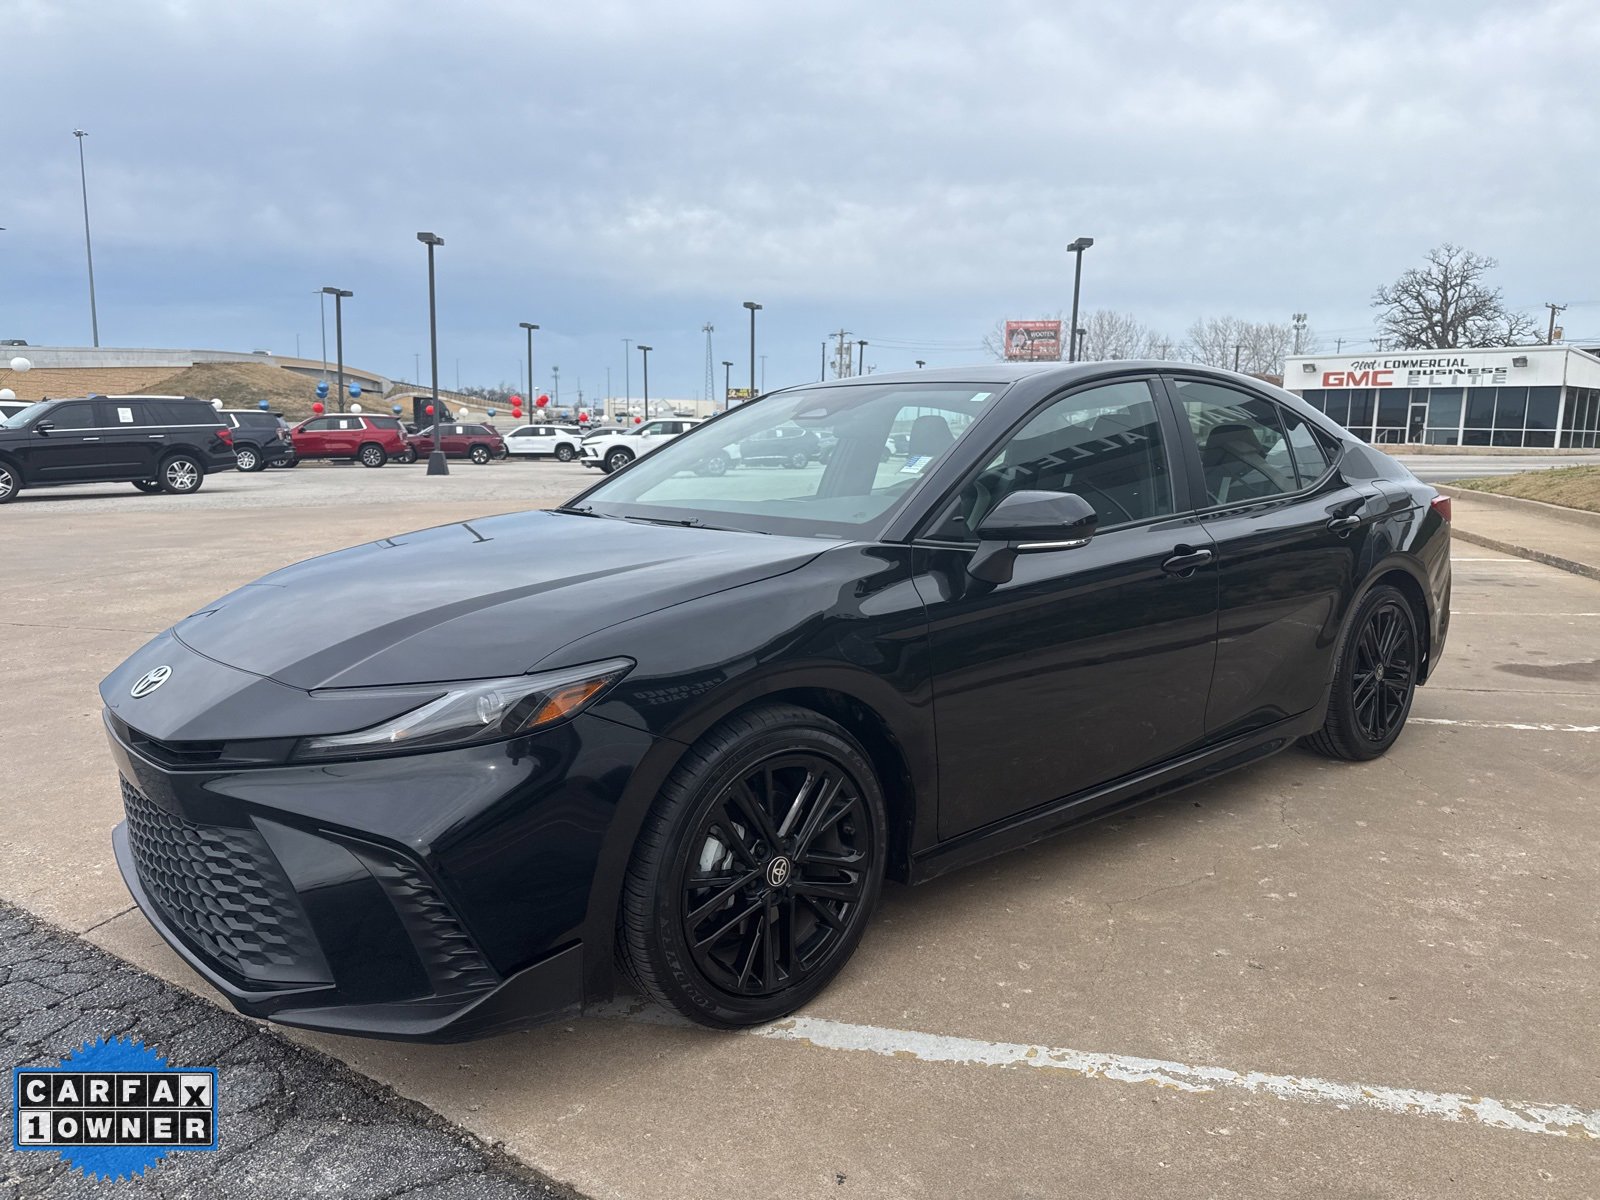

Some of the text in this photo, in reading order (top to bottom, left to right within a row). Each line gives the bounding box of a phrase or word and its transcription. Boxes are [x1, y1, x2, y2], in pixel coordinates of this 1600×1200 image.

[1351, 359, 1377, 371] Fleet
[1383, 358, 1469, 369] COMMERCIAL
[1408, 366, 1508, 376] BUSINESS
[1322, 370, 1394, 387] GMC
[1406, 373, 1507, 386] ELITE
